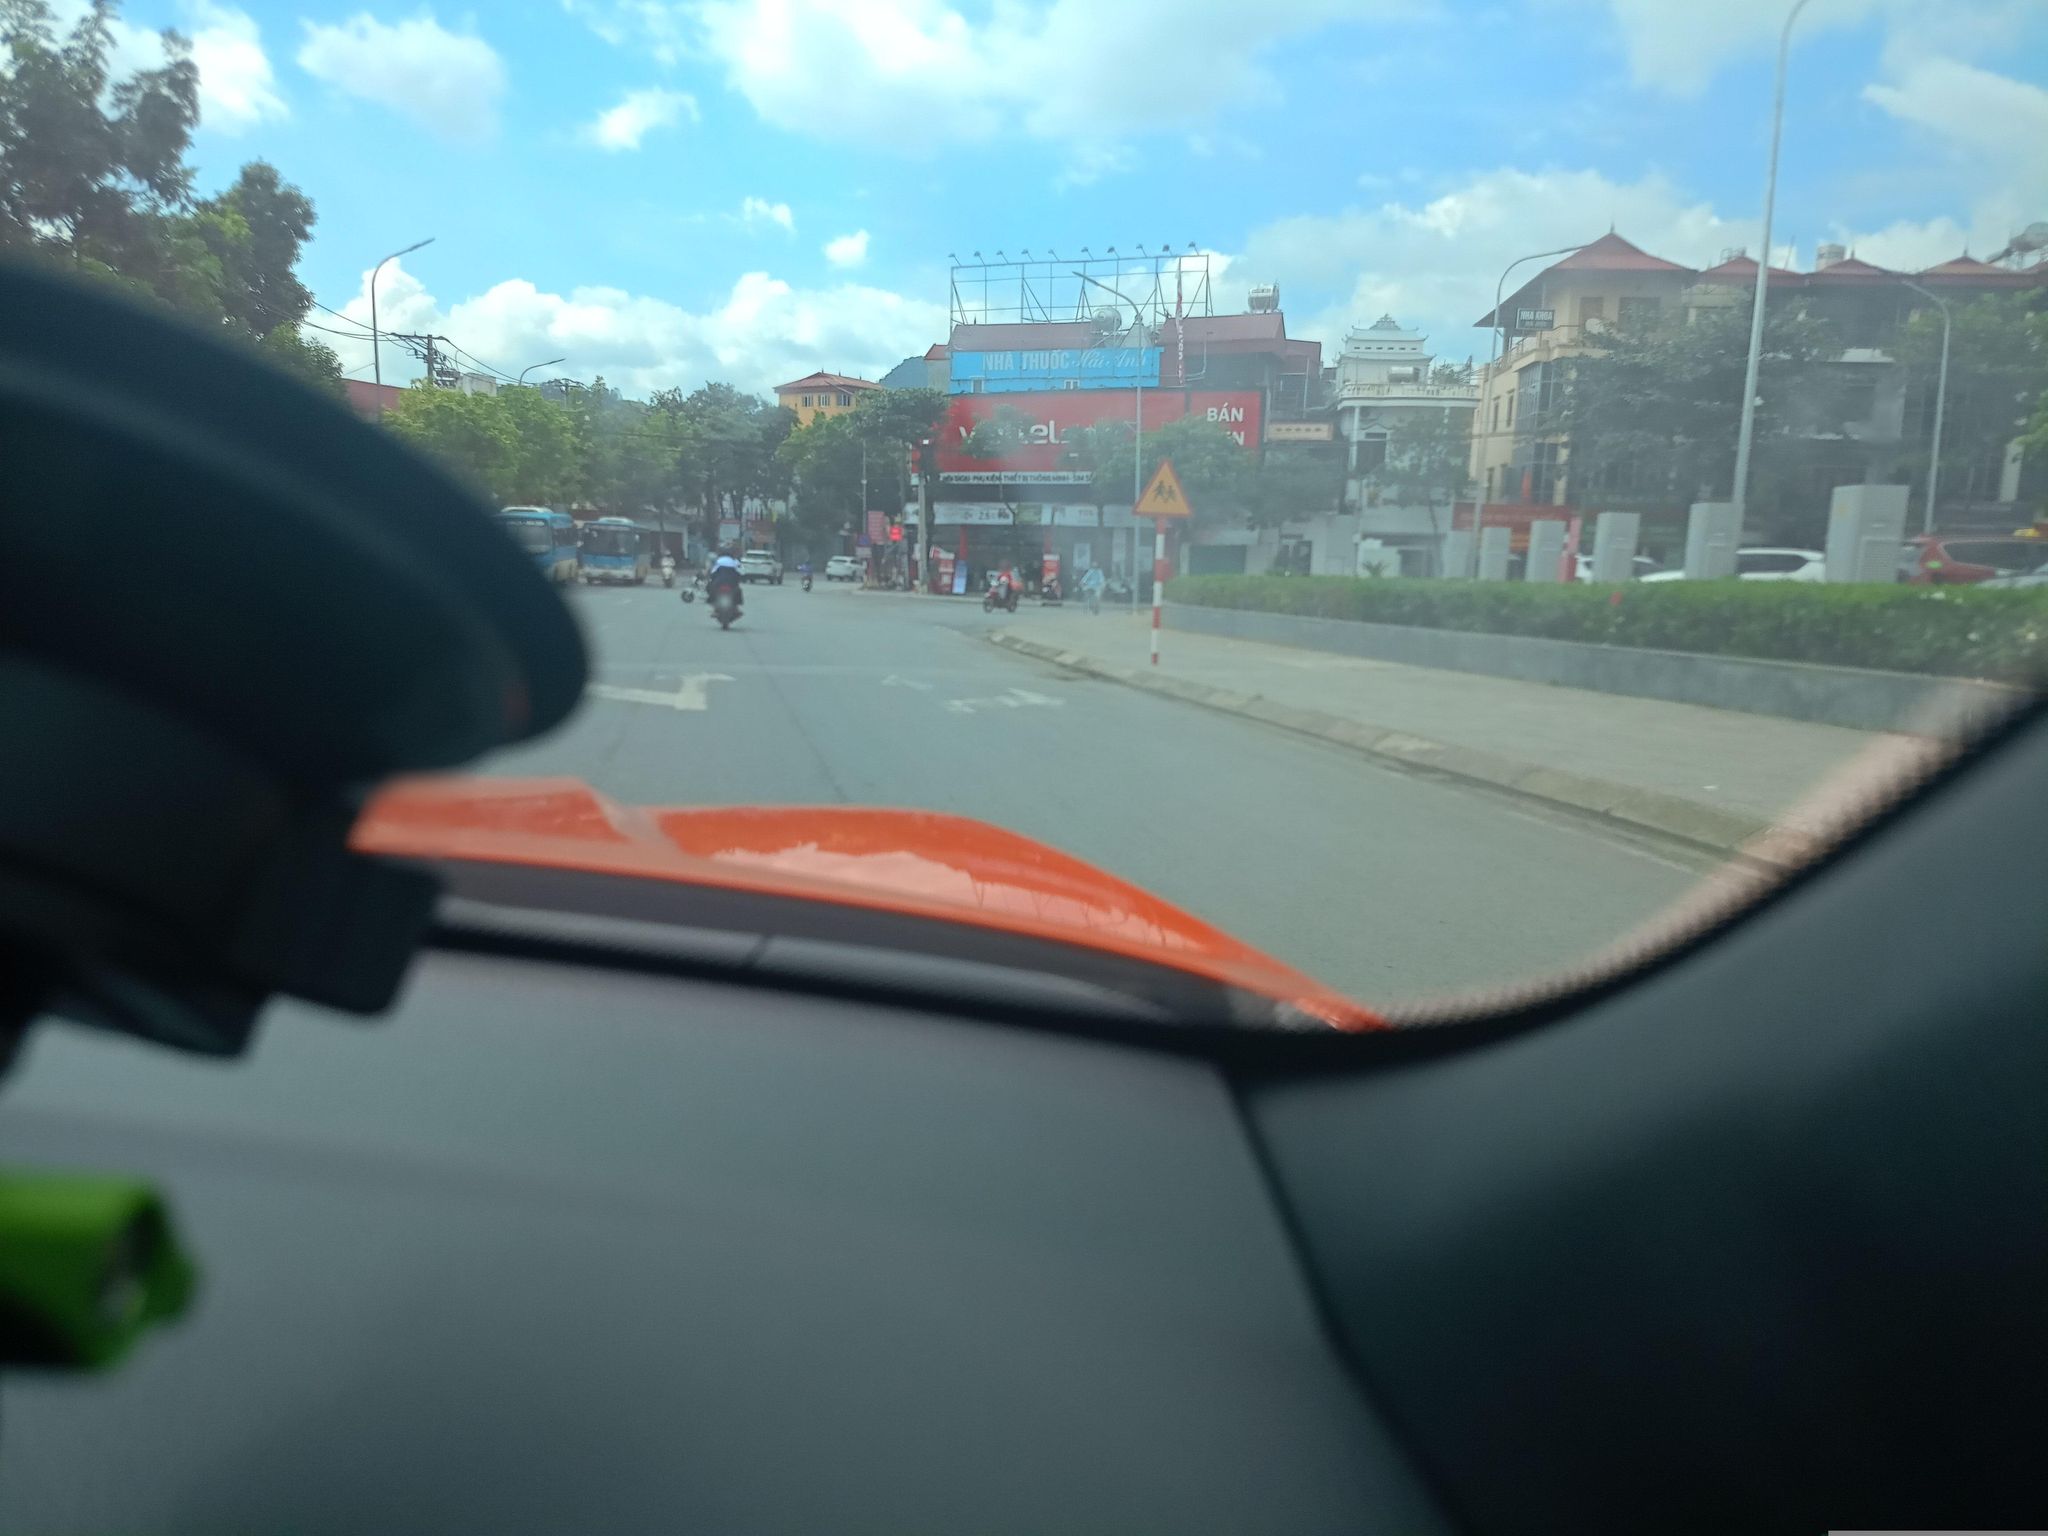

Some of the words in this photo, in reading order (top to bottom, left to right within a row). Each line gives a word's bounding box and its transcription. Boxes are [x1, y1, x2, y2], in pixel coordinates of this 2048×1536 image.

[984, 350, 1014, 371] NHÀ
[1022, 349, 1070, 371] THUỐC
[1207, 402, 1243, 422] BÁN
